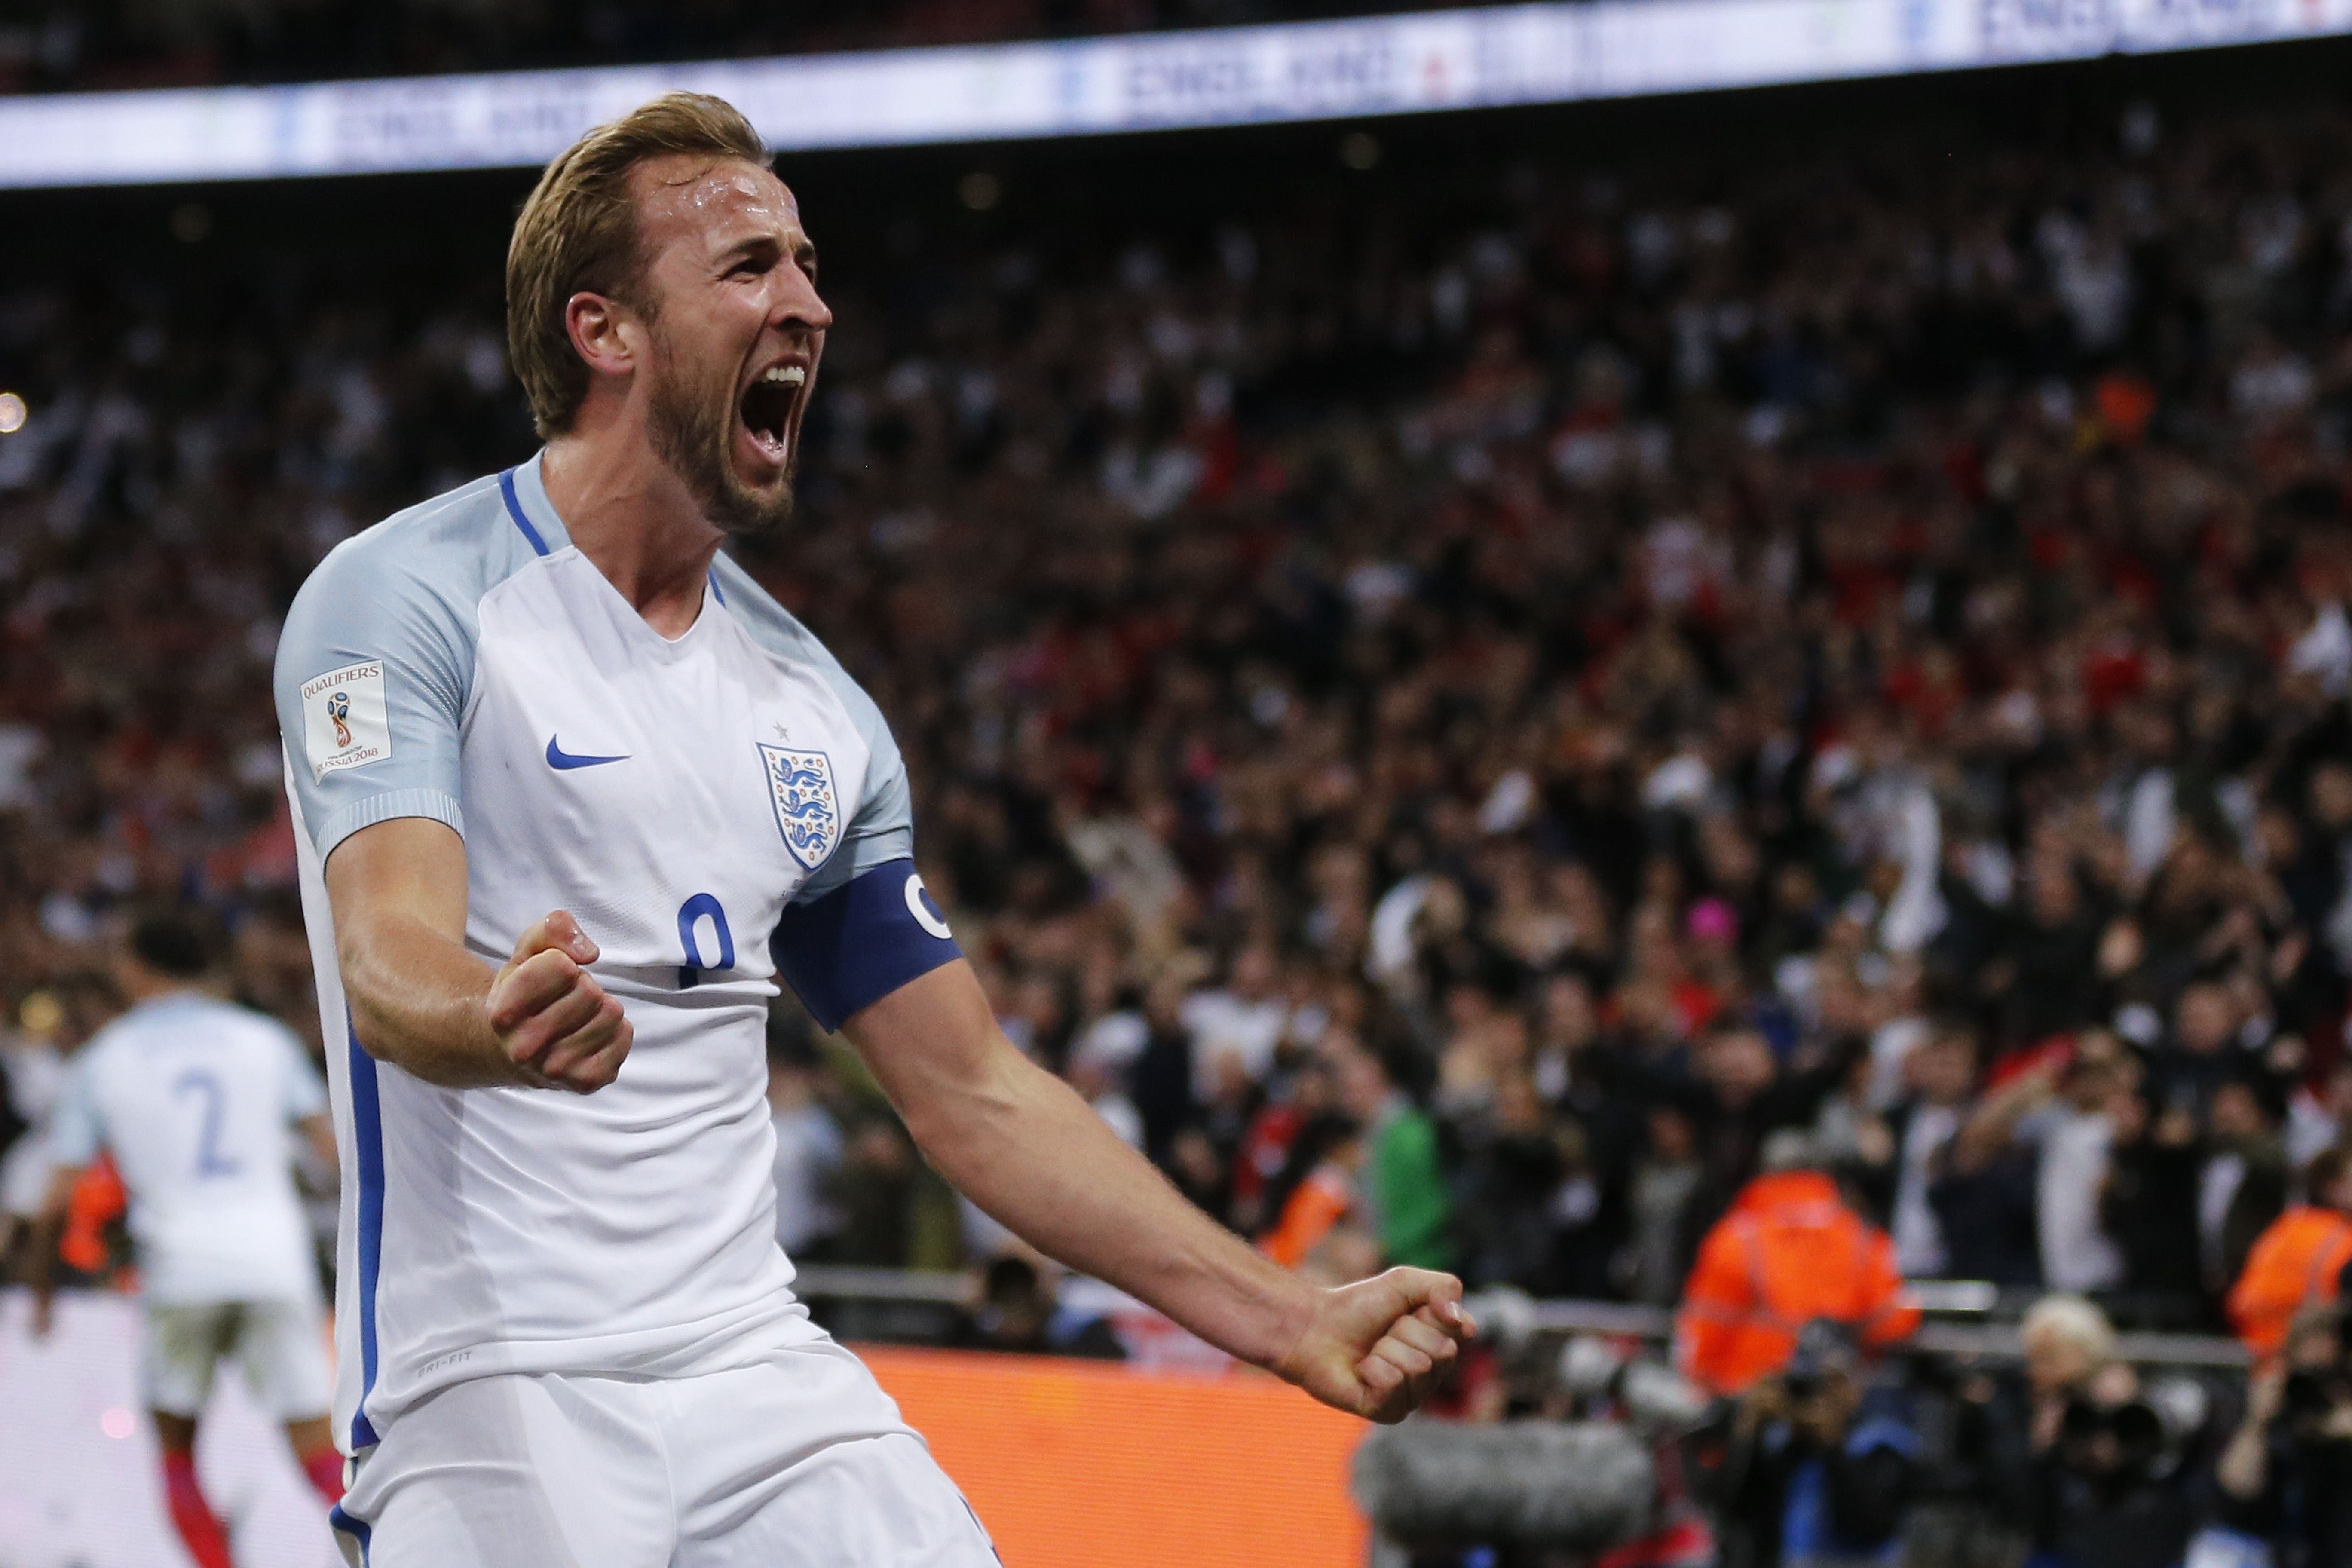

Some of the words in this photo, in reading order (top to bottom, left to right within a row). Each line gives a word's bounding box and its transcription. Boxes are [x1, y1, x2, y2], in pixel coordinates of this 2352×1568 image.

[304, 666, 379, 700] QUALIFIERS
[316, 756, 352, 774] RUSSIA
[354, 748, 378, 762] 2018
[173, 1068, 243, 1179] 2
